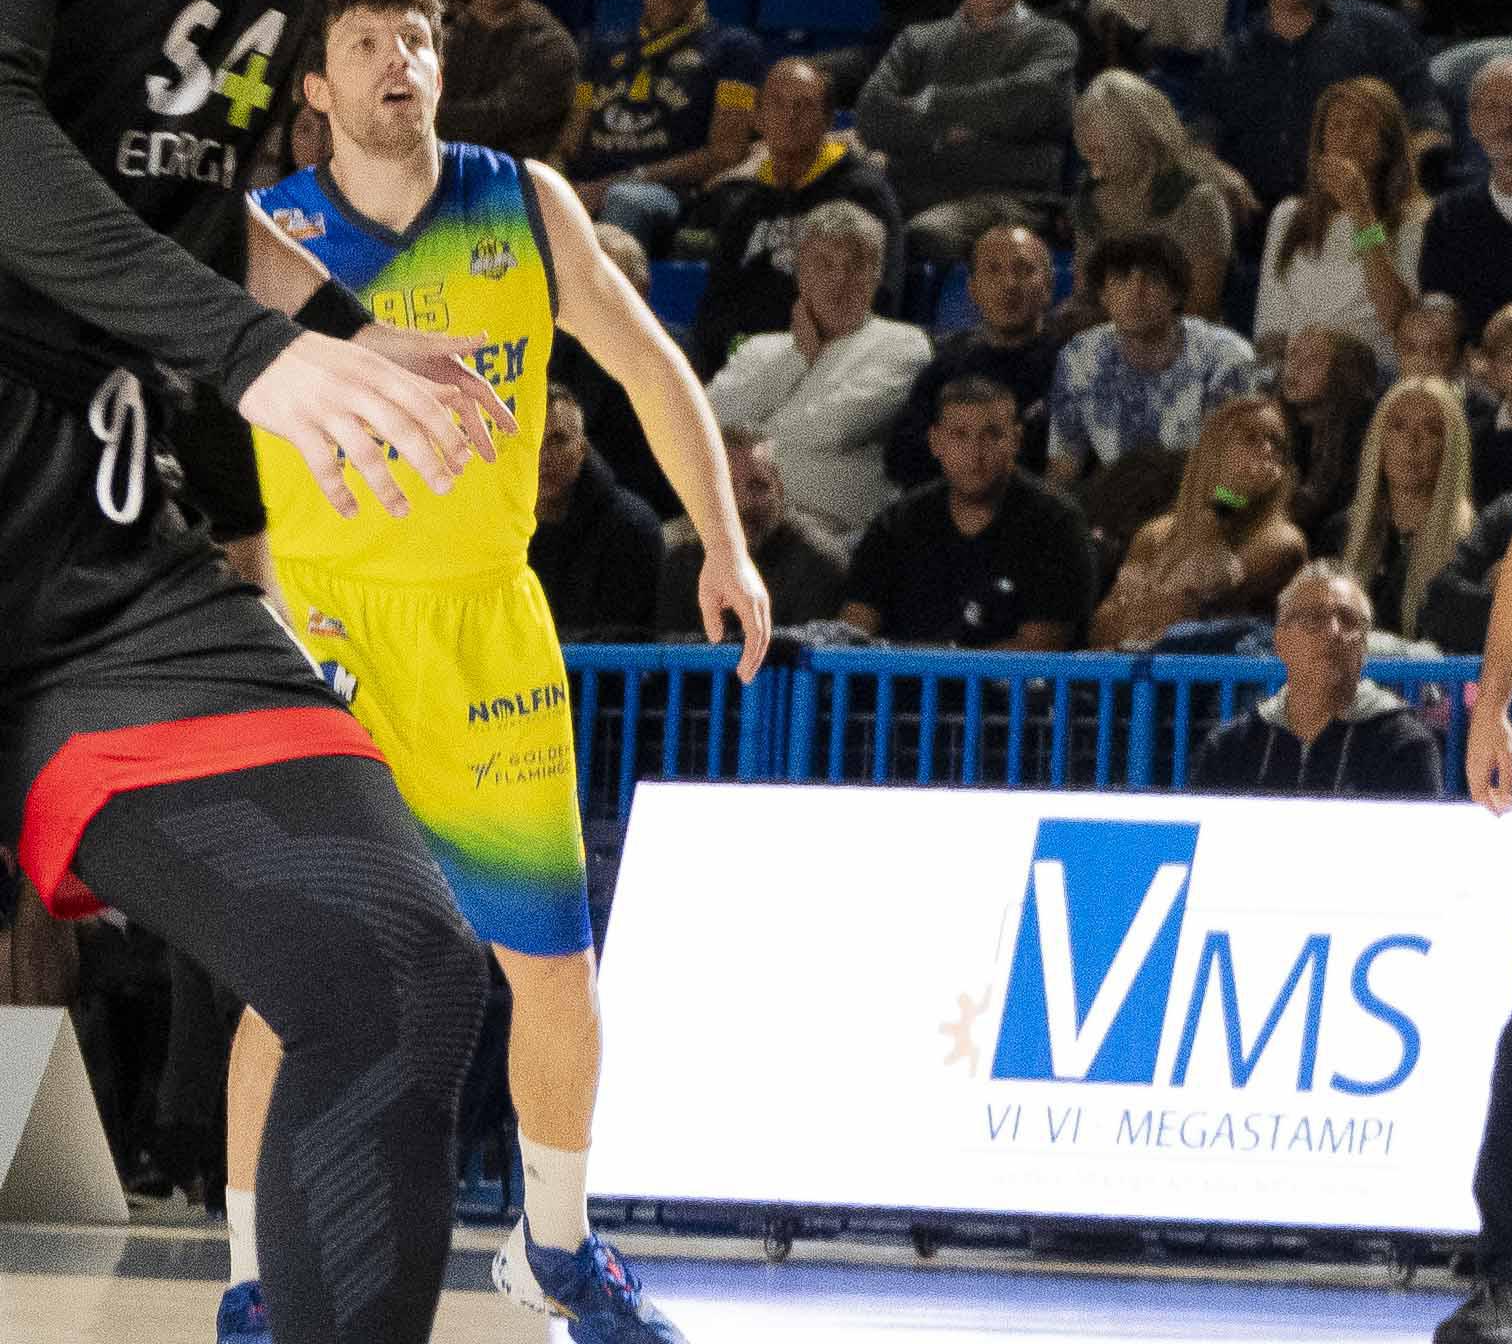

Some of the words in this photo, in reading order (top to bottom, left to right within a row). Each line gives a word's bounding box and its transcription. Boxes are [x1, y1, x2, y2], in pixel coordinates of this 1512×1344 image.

[1034, 858, 1433, 1098] VMS
[987, 1103, 1021, 1143] VI
[1047, 1105, 1082, 1145] VI
[1116, 1108, 1395, 1156] MEGASTAMPI
